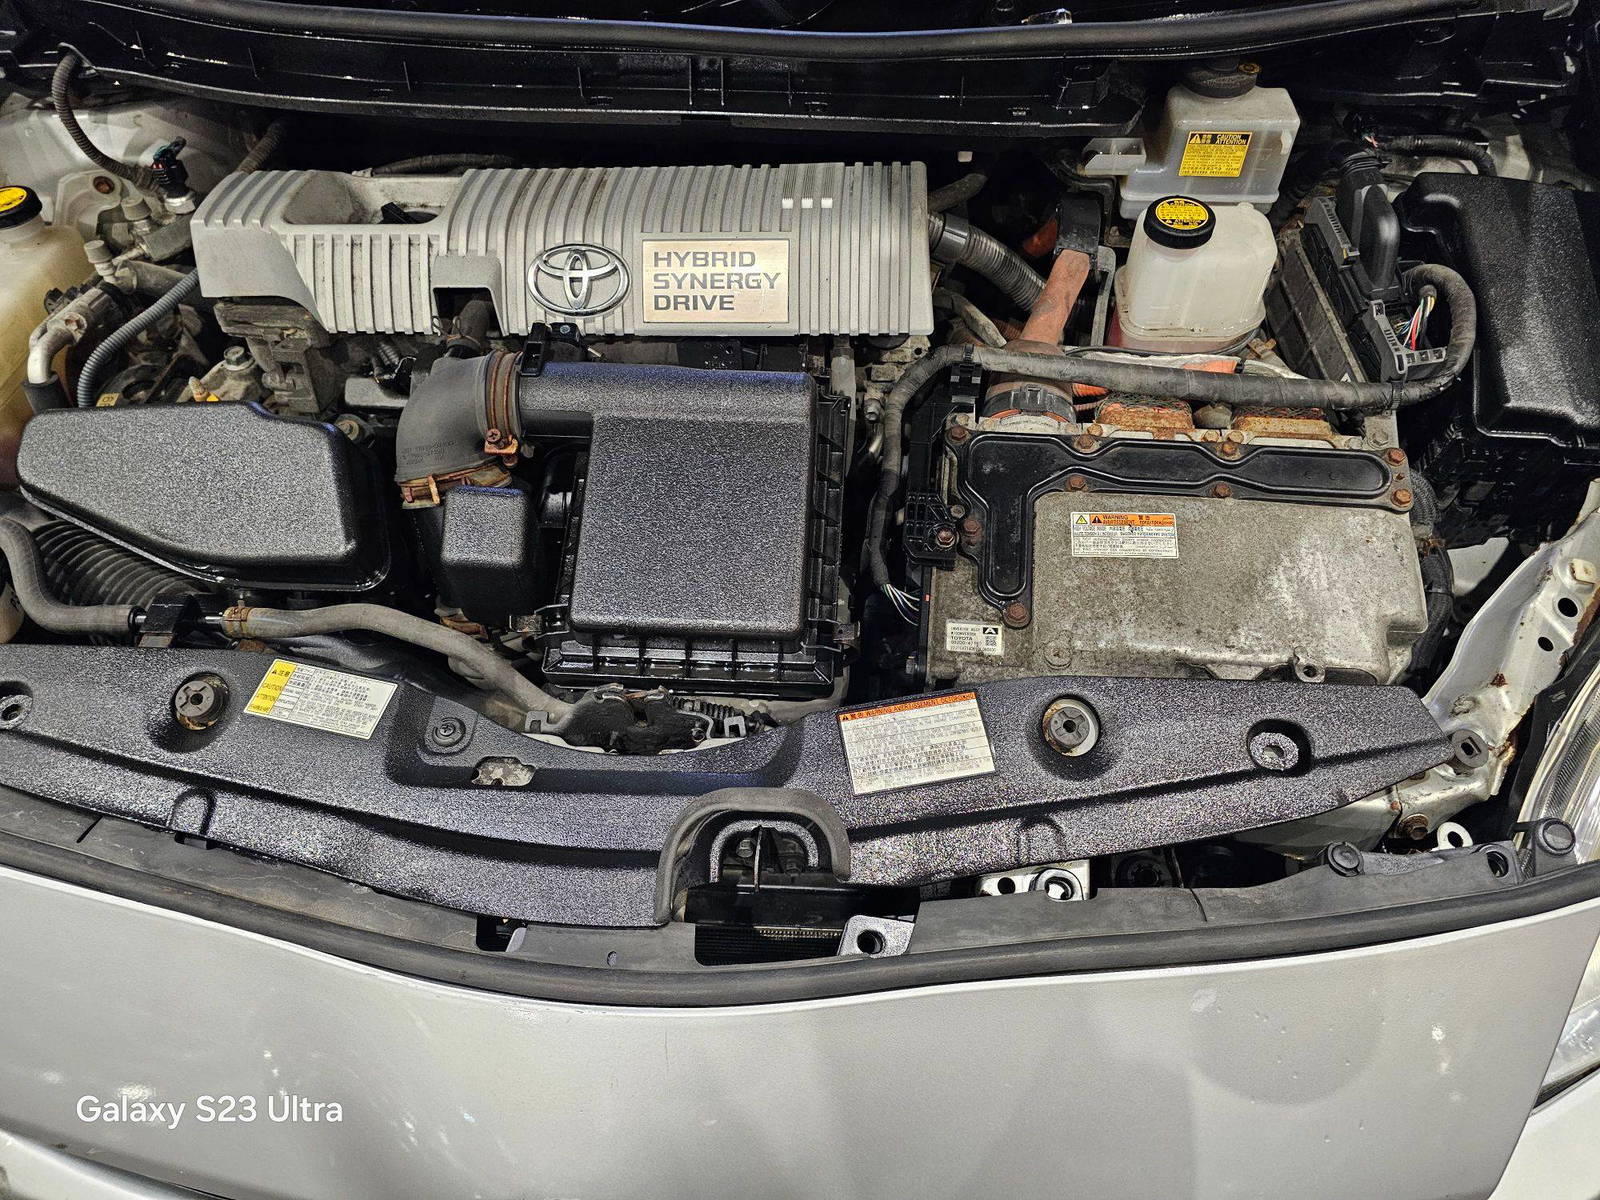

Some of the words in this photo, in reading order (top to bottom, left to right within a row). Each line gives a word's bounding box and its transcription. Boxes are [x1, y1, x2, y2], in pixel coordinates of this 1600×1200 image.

[654, 251, 756, 268] HYBRID
[653, 272, 781, 290] SYNERGY
[654, 294, 735, 311] DRIVE
[262, 682, 283, 691] CAUTION
[866, 707, 892, 717] WARNING
